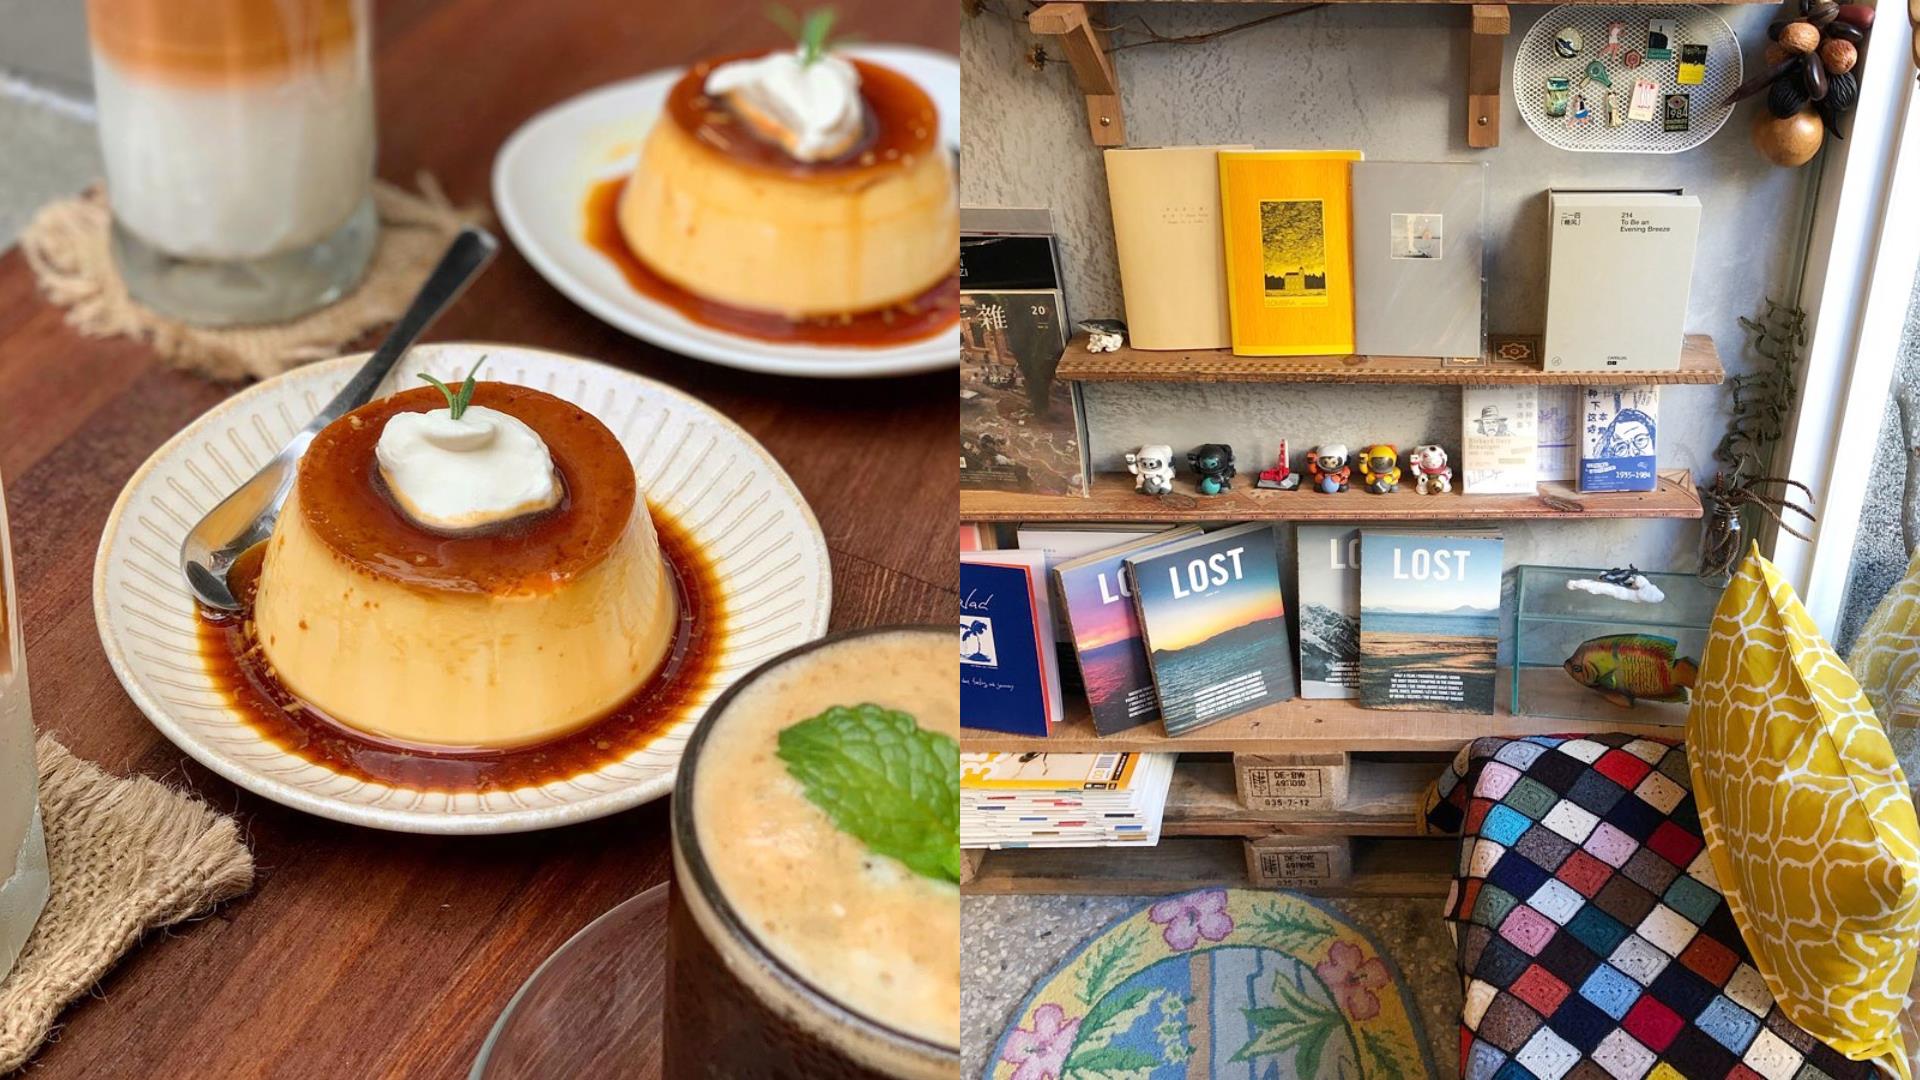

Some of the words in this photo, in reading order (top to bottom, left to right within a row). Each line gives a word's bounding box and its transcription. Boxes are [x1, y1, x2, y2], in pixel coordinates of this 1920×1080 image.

[1030, 305, 1046, 315] 20
[1168, 547, 1244, 600] LOST
[1393, 547, 1471, 582] LOST
